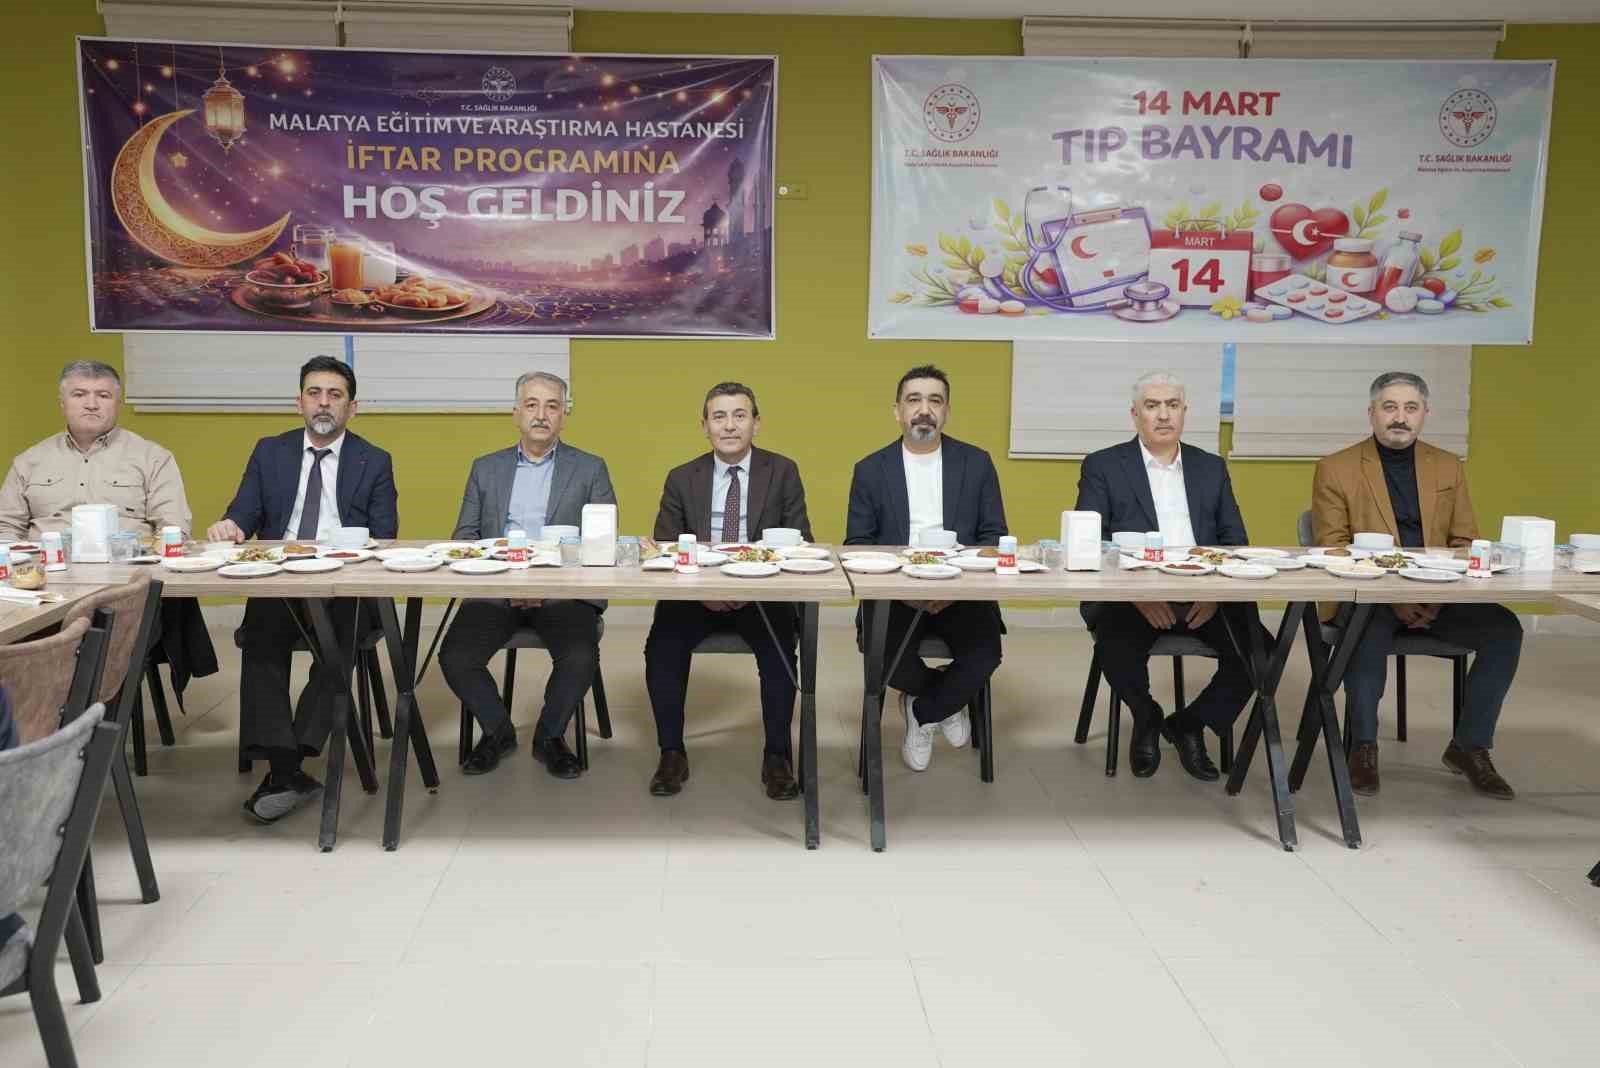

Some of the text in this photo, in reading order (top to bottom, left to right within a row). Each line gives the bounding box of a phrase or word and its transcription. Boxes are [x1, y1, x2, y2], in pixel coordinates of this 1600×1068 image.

[1134, 90, 1281, 117] 14 MART
[269, 111, 745, 139] MALATYA EĞİTİM VE ARAŞTIRMA HASTANESİ
[347, 140, 681, 174] İFTAR PROGRAMINA
[952, 148, 999, 158] BAKANLIĞI
[1052, 124, 1353, 169] TIP BAYRAMI
[343, 181, 686, 230] HOŞ GELDİNİZ
[1185, 236, 1216, 248] MART
[1171, 257, 1225, 294] 14
